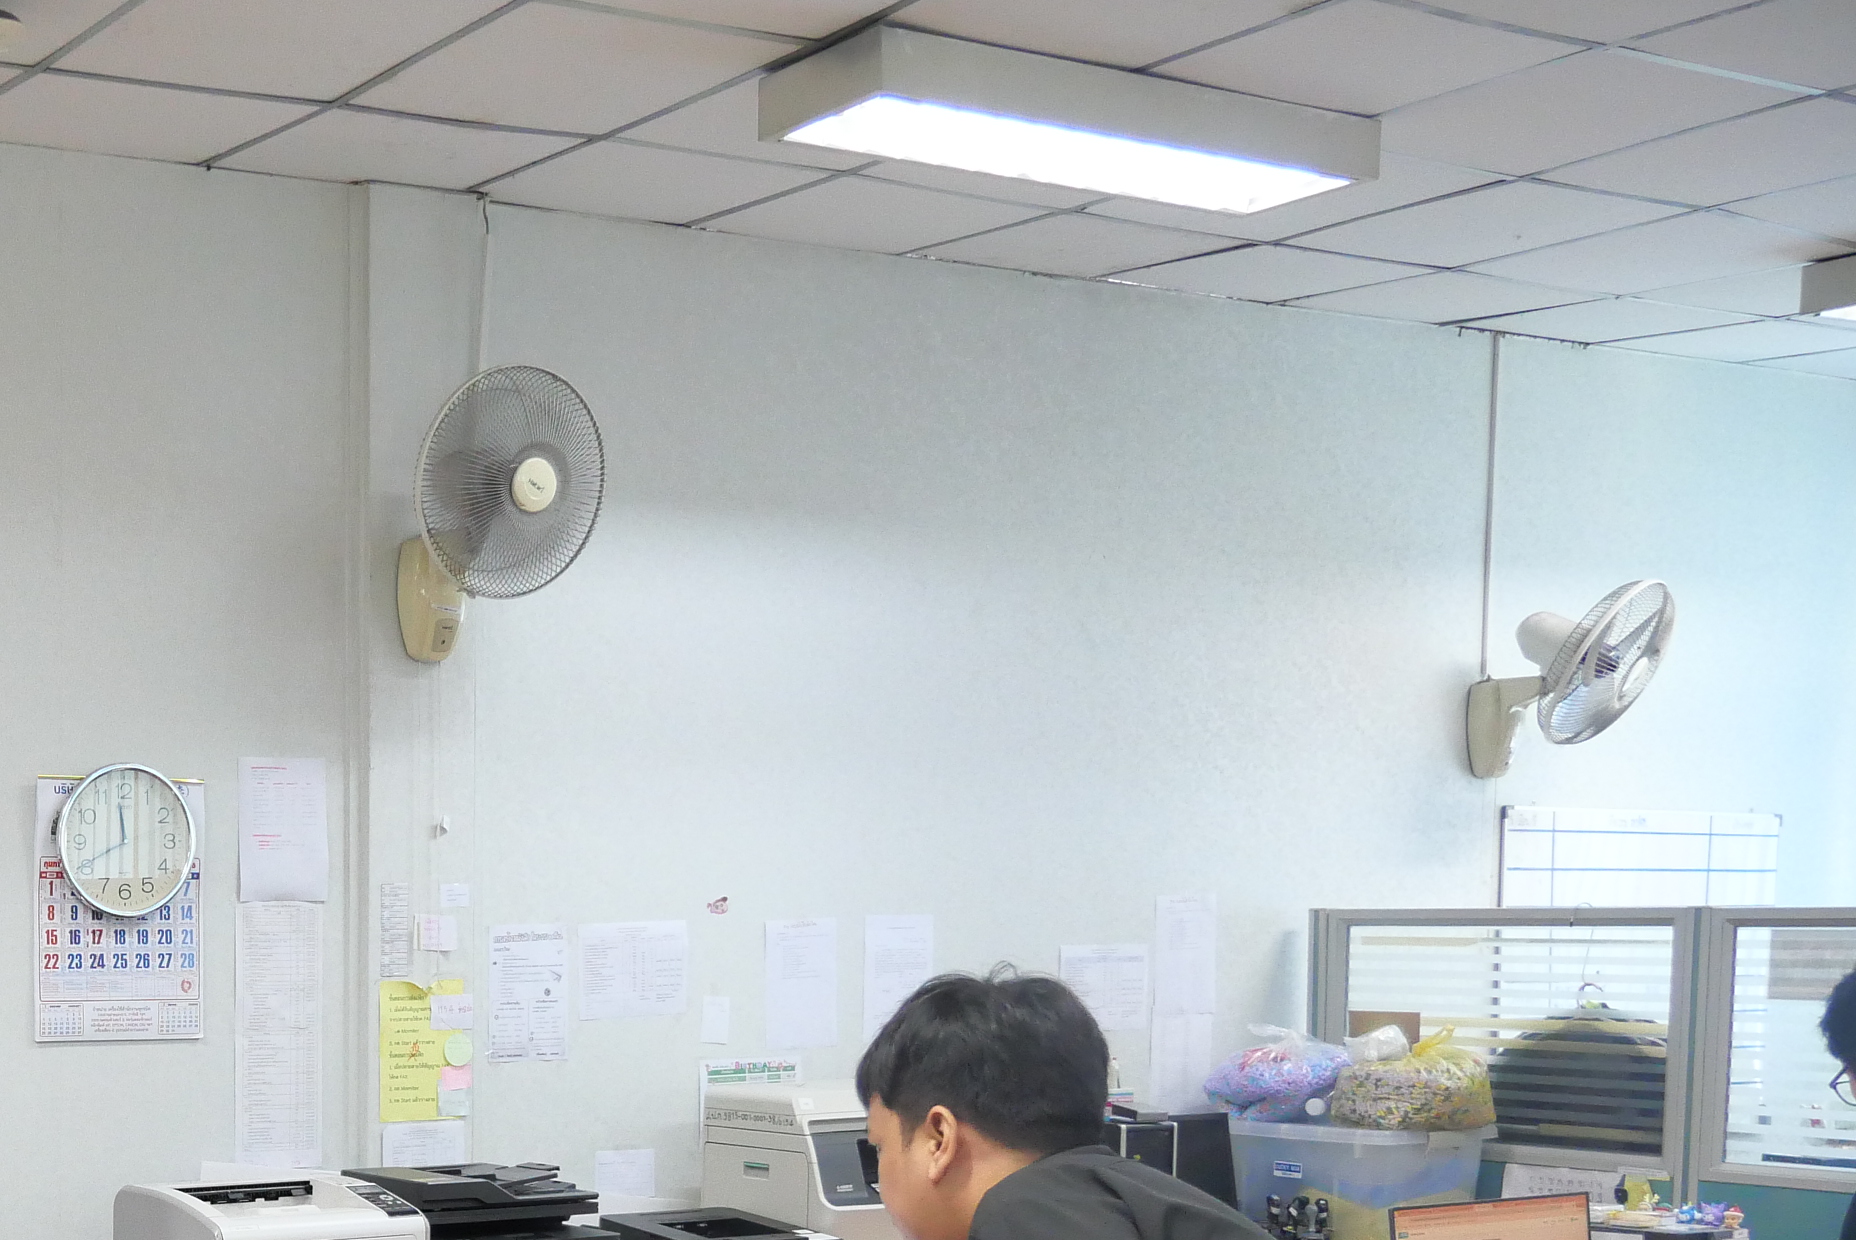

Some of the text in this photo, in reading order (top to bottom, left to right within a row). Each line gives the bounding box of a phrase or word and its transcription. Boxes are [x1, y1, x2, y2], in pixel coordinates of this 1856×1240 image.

[96, 788, 108, 805] 11
[115, 782, 133, 800] 12
[144, 788, 150, 805] 1
[78, 808, 96, 825] 10
[157, 807, 170, 824] 2
[73, 834, 86, 850] 9
[163, 833, 176, 850] 3
[80, 858, 94, 875] 8
[157, 858, 170, 874] 4
[48, 881, 54, 896] 1
[98, 877, 110, 894] 7
[118, 883, 132, 900] 6
[141, 877, 154, 893] 5
[47, 905, 55, 921] 8
[71, 905, 78, 921] 9
[159, 905, 171, 921] 13
[180, 905, 194, 921] 14
[45, 929, 194, 945] 15 16 17 18 19 20 21
[44, 953, 195, 970] 22 23 24 25 26 27 28
